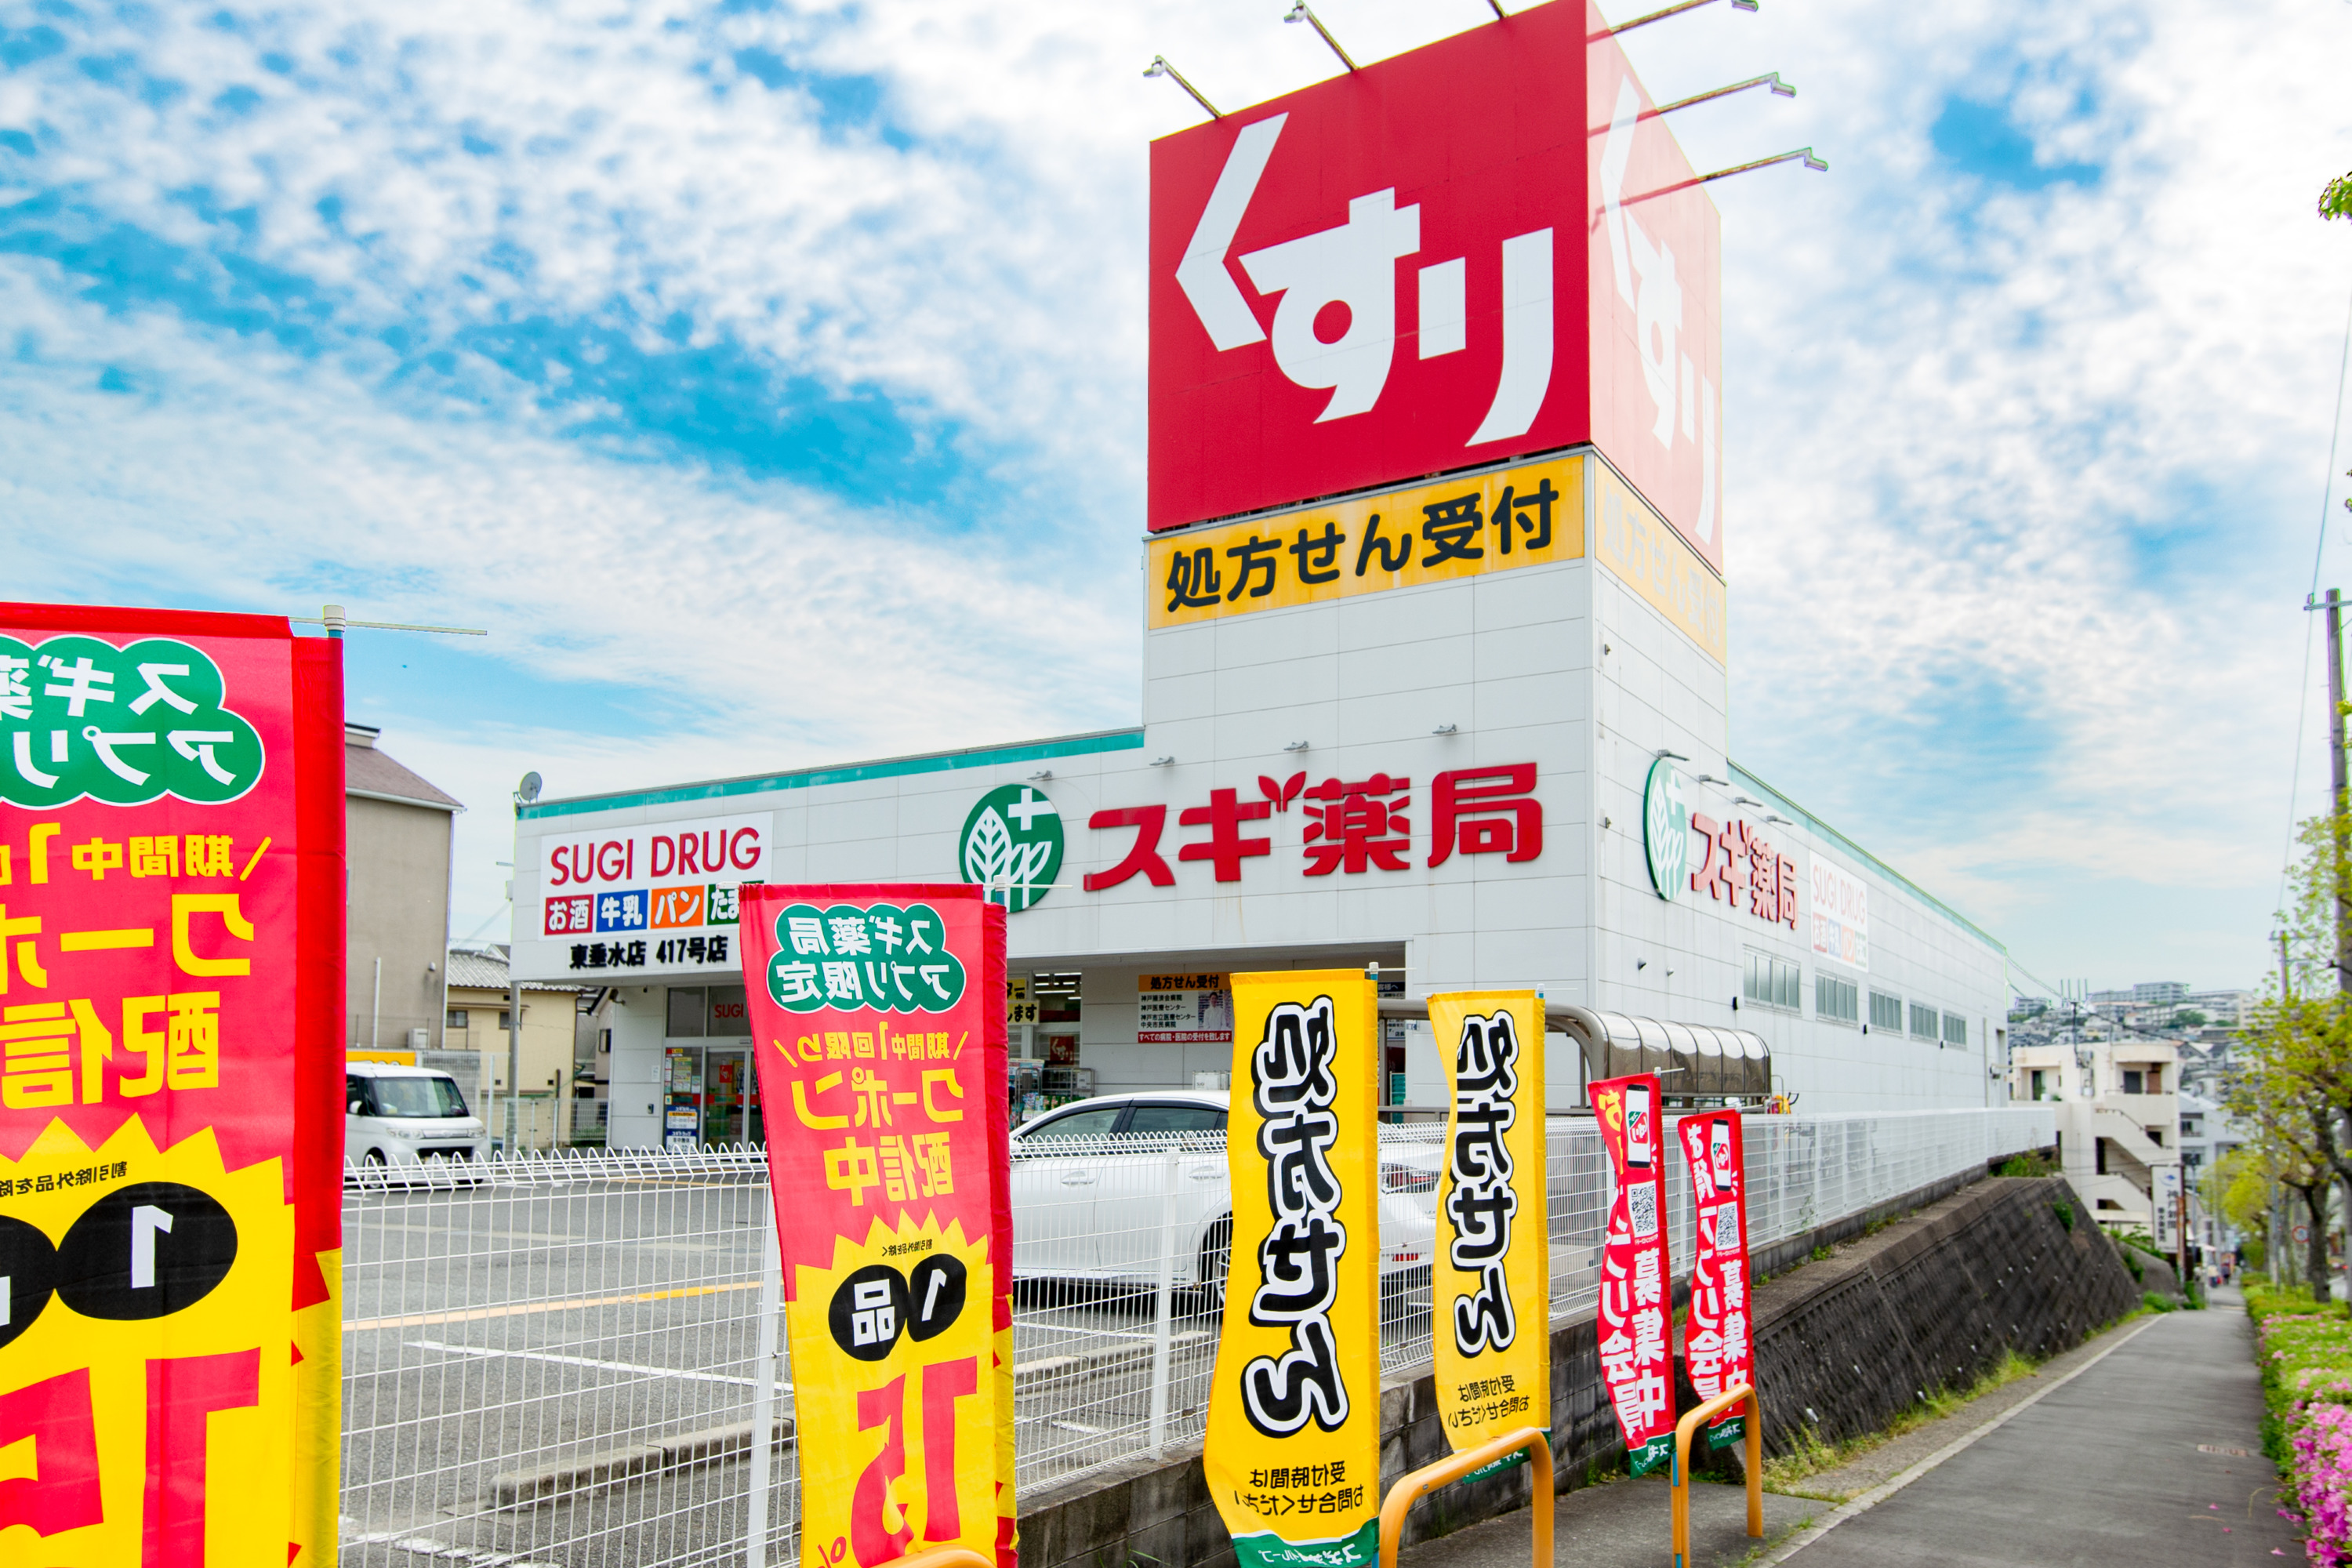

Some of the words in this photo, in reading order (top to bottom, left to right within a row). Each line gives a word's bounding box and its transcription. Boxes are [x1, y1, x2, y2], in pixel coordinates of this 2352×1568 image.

[1175, 112, 1553, 446] くすり
[1599, 74, 1715, 546] くすり
[1167, 478, 1559, 612] 処方せん受付
[1602, 483, 1720, 648] 処方せん受付
[550, 839, 633, 886] SUGI
[651, 827, 761, 878] DRUG
[1083, 762, 1543, 892] スギ薬局
[1691, 812, 1798, 931] スギ薬局
[549, 899, 590, 931] お酒
[601, 895, 643, 928] 牛乳
[655, 891, 700, 925] パン
[1813, 865, 1837, 913] SUGI
[1840, 879, 1866, 925] DRUG
[570, 940, 647, 969] 東垂水店
[656, 935, 728, 964] 417号店
[1150, 975, 1220, 989] 処方せん受付
[714, 1004, 743, 1018] SUGI
